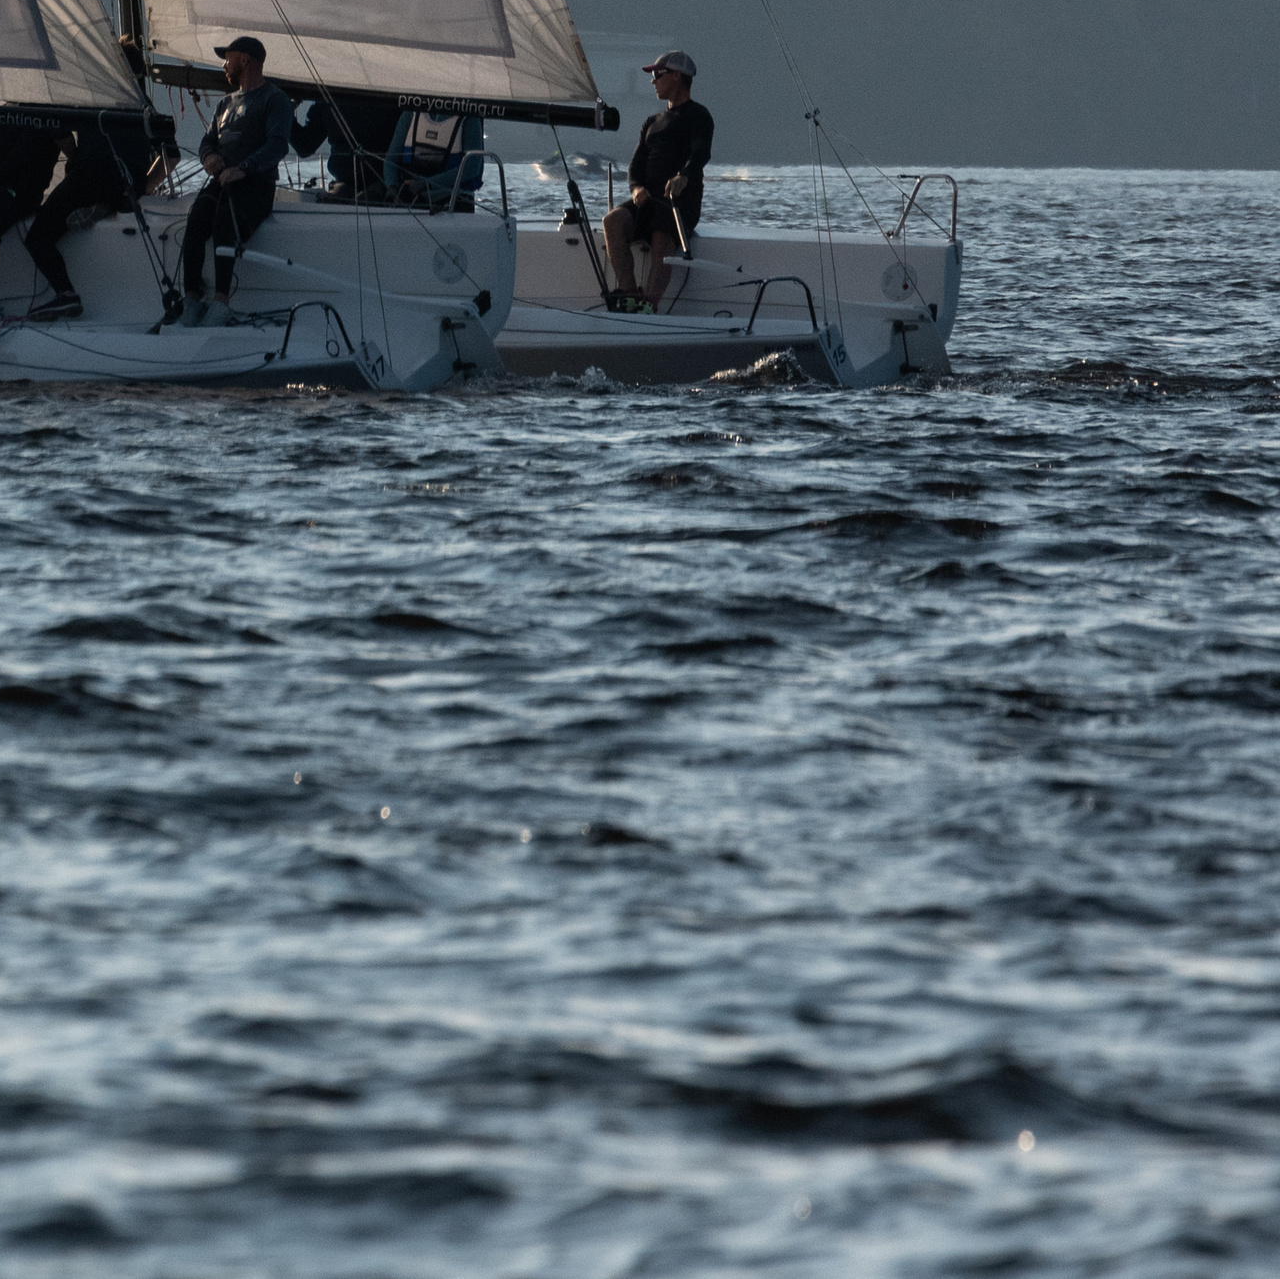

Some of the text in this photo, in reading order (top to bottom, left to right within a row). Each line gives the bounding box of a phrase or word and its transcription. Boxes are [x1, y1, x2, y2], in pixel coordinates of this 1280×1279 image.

[398, 94, 506, 117] pro-yachting.ru
[832, 344, 847, 367] 15
[370, 354, 386, 382] 17
